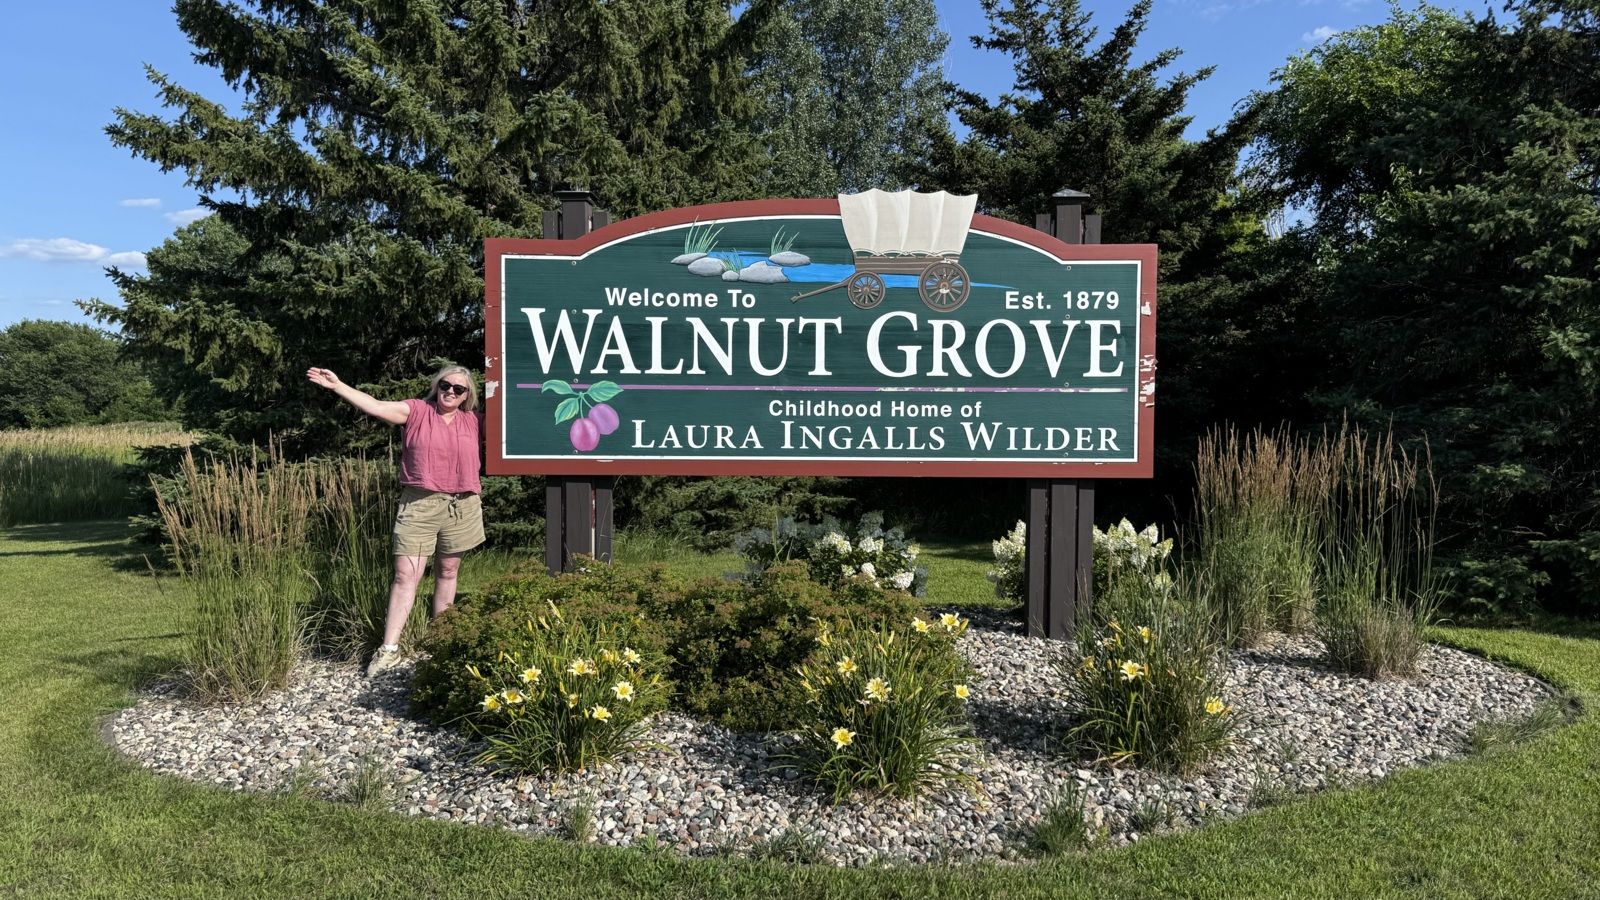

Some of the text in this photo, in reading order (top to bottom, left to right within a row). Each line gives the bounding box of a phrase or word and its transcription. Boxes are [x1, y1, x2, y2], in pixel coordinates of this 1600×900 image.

[604, 287, 756, 309] Welcome To
[1005, 290, 1120, 310] Est. 1879
[521, 307, 1123, 377] WALNUT GROVE
[768, 399, 982, 418] Childhood Home of
[632, 420, 1120, 451] LAURA INGALLS WILDER
